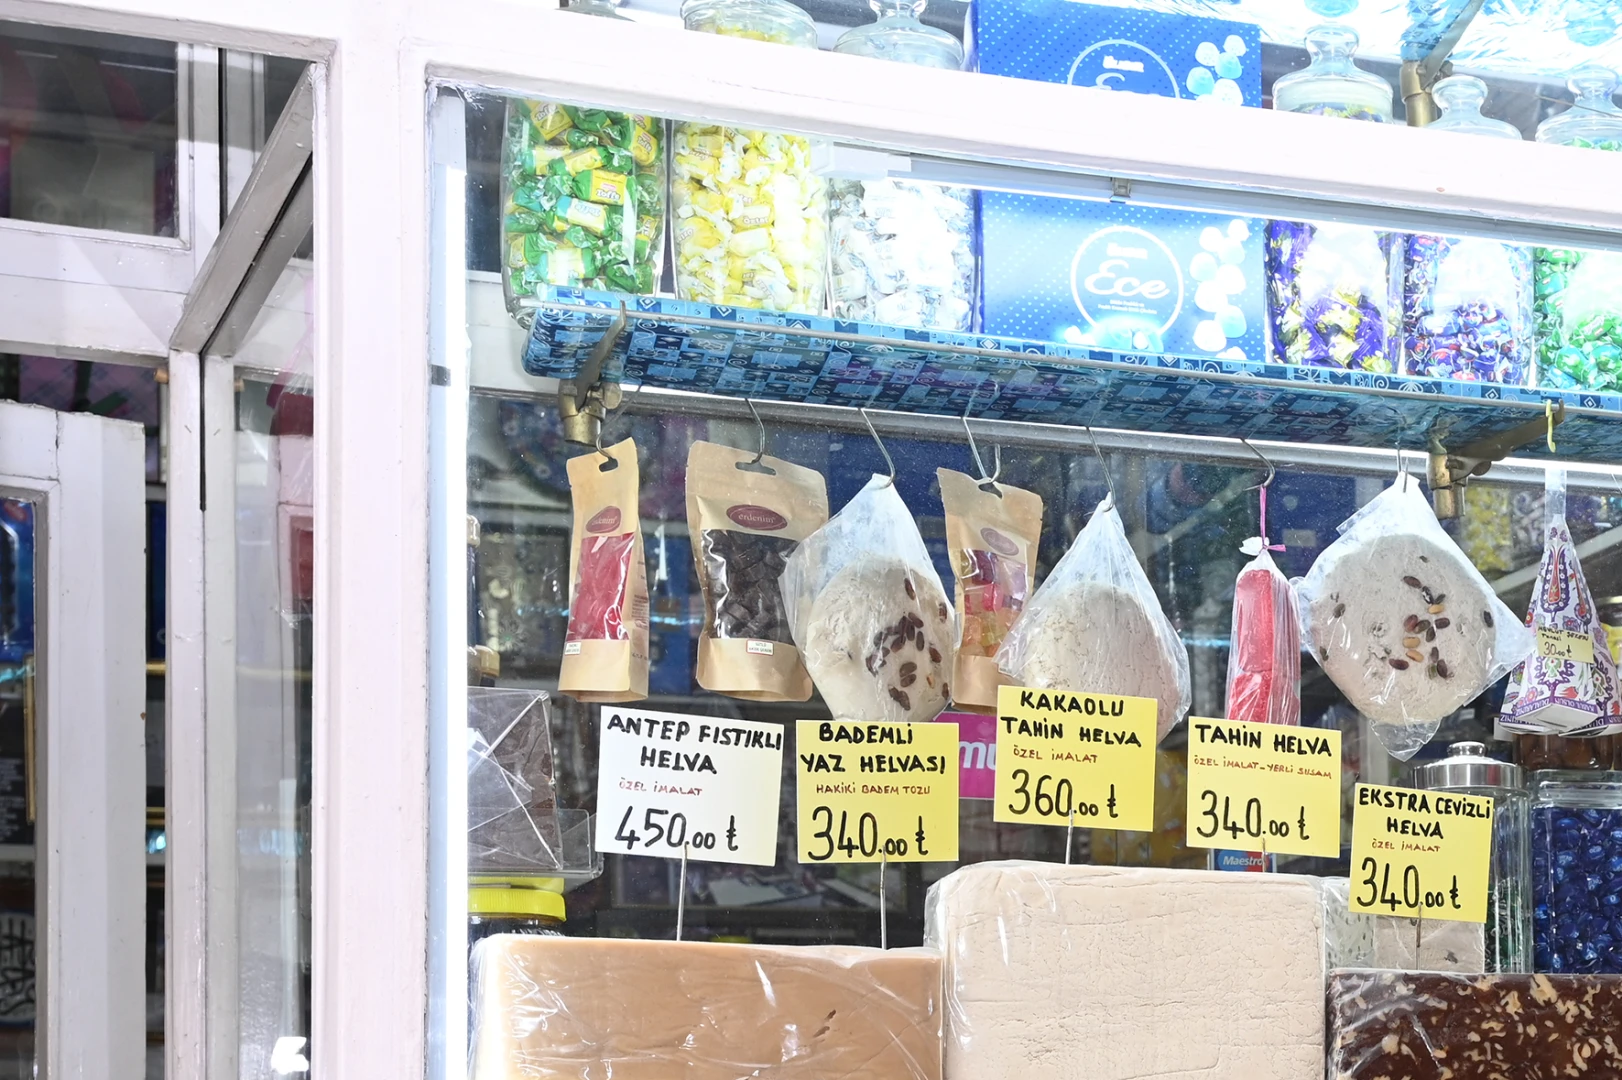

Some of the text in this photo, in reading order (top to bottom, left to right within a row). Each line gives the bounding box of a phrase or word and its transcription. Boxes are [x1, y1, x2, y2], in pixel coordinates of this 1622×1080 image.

[1083, 259, 1170, 300] Ece
[1020, 690, 1125, 717] KAKAOLU
[607, 713, 783, 751] ANTEP FISTIKLI
[818, 722, 914, 746] BADEMLİ
[1000, 716, 1142, 748] TAHİN HELVA
[1194, 723, 1333, 757] TAHİN HELVA
[640, 748, 718, 775] HELVA
[800, 752, 946, 775] YAZ HELVASI
[1012, 745, 1045, 762] ÖZEL
[1193, 755, 1219, 767] ÖZEL
[1297, 766, 1333, 781] SUSAM
[861, 783, 900, 796] BADEM
[901, 784, 931, 796] TOZU
[1358, 787, 1491, 819] EKSTRA CEVİZLİ
[1386, 816, 1444, 840] HELVA
[1371, 838, 1395, 851] ÖZEL
[1222, 853, 1265, 868] Maestro
